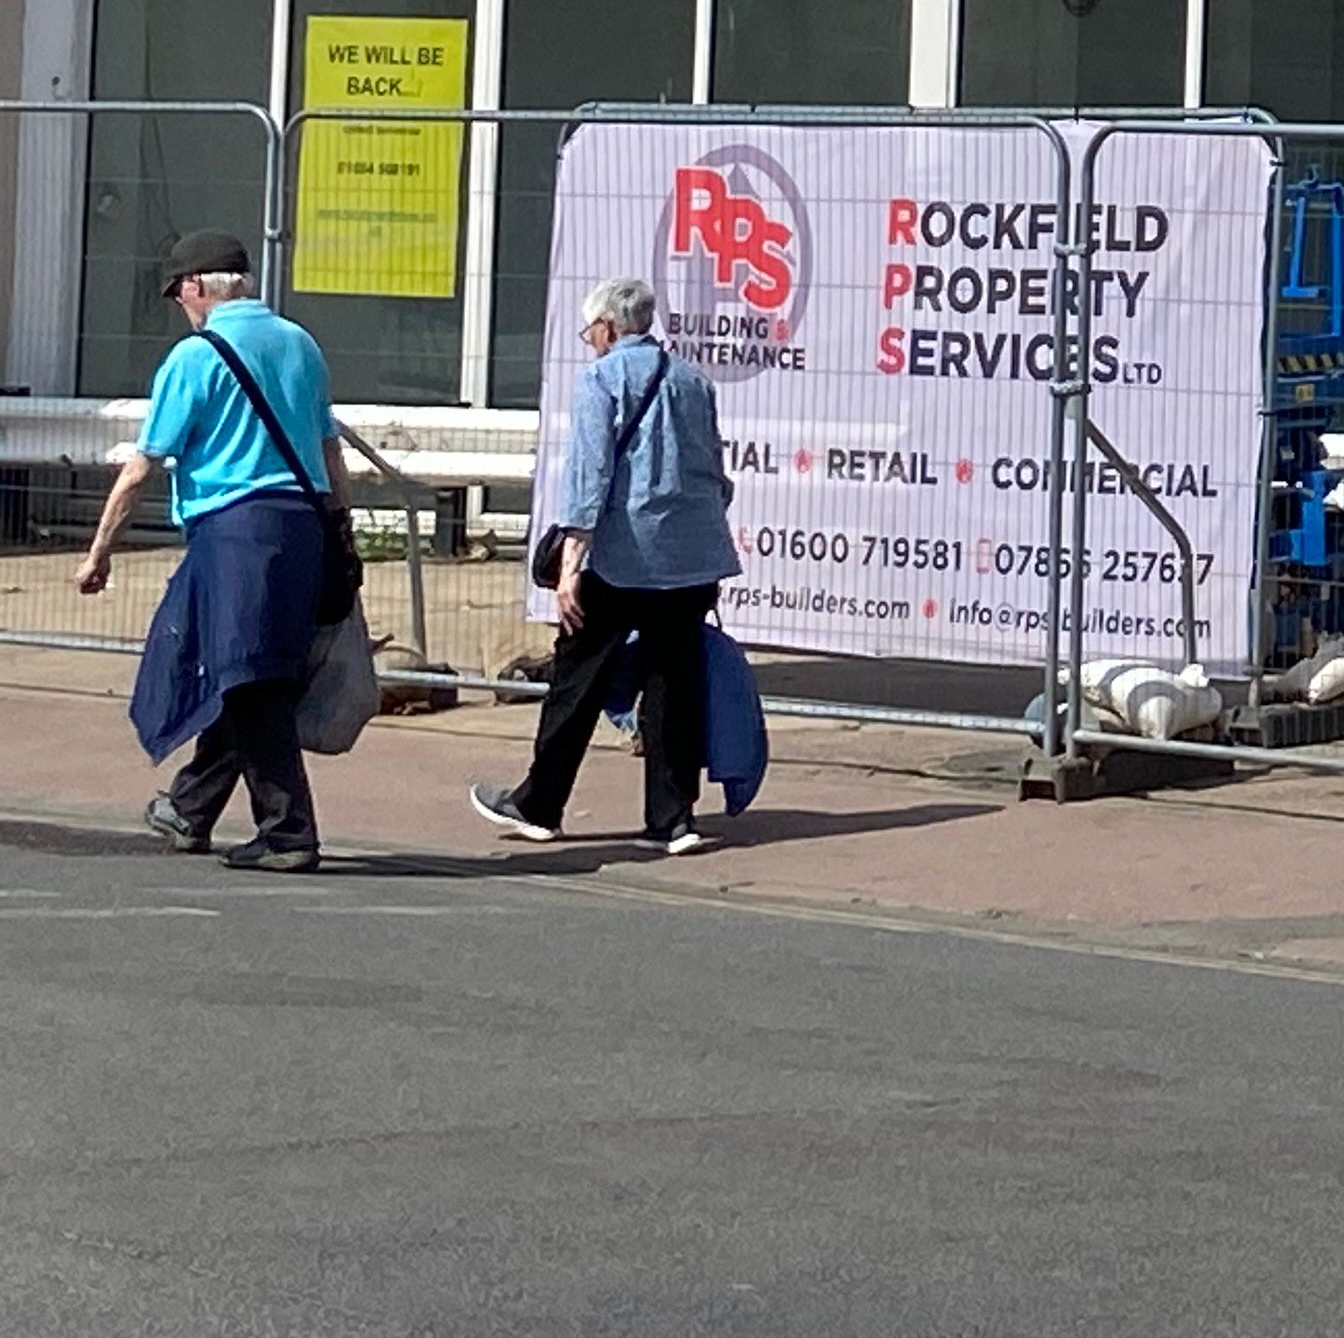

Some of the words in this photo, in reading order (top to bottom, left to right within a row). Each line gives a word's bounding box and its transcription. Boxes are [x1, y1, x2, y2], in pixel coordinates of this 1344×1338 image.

[328, 44, 359, 65] WE
[365, 45, 411, 66] WILL
[417, 46, 444, 67] BE
[674, 168, 793, 310] RPS
[668, 313, 770, 340] BUILDING
[659, 340, 806, 370] AINTENANCE
[1123, 363, 1162, 384] LTD
[827, 447, 938, 485] RETAIL
[757, 527, 849, 564] 01600
[862, 535, 962, 573] 719581
[1103, 549, 1215, 586] 25767
